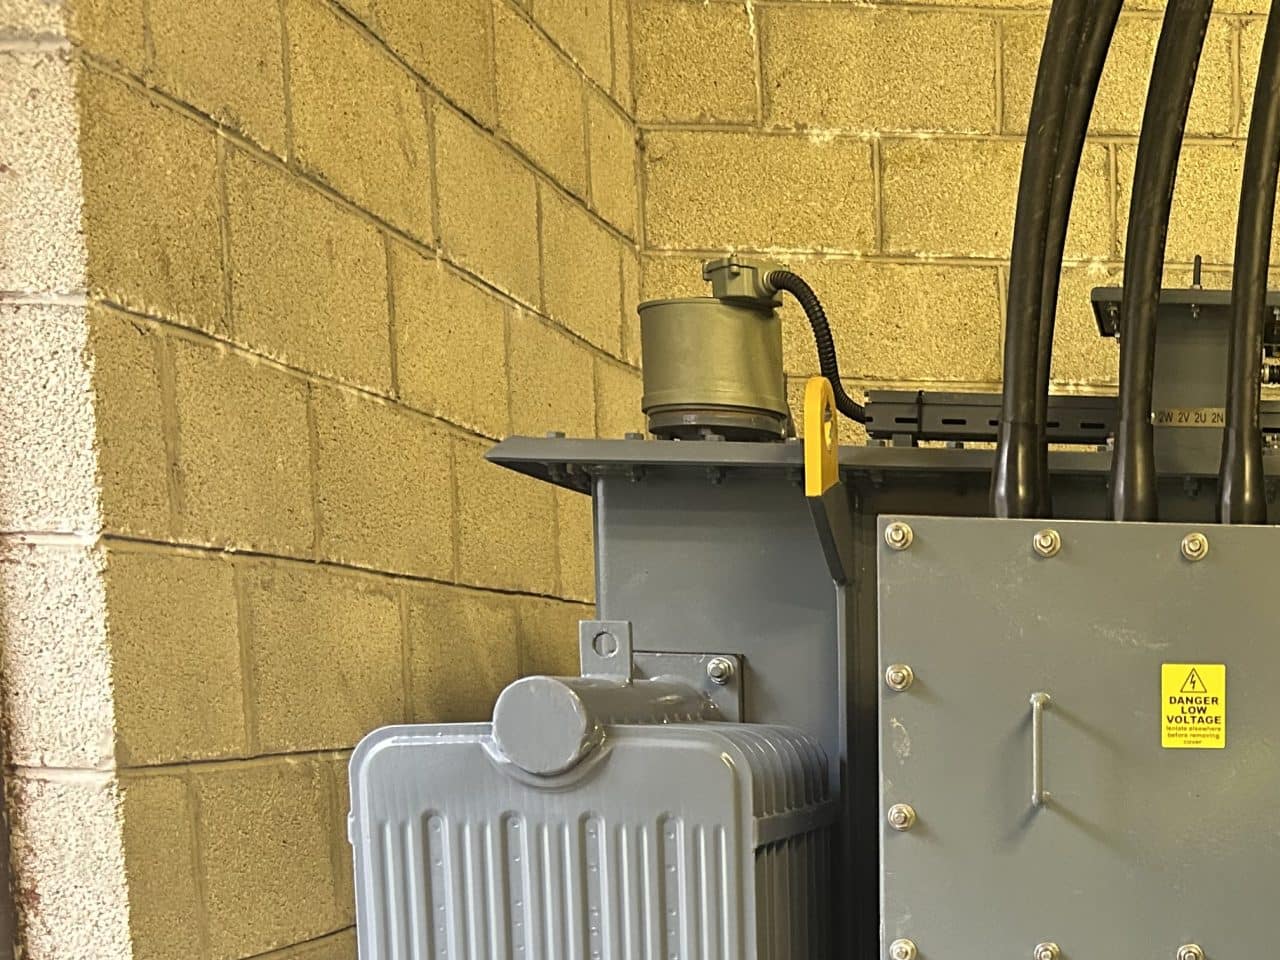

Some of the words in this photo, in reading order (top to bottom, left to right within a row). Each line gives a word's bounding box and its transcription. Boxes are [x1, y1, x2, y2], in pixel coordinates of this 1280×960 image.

[1178, 411, 1190, 423] 2V
[1194, 412, 1207, 424] 2U
[1211, 411, 1224, 424] 2N
[1169, 696, 1219, 705] DANGER
[1181, 706, 1207, 715] LOW
[1166, 715, 1222, 725] VOLTAGE
